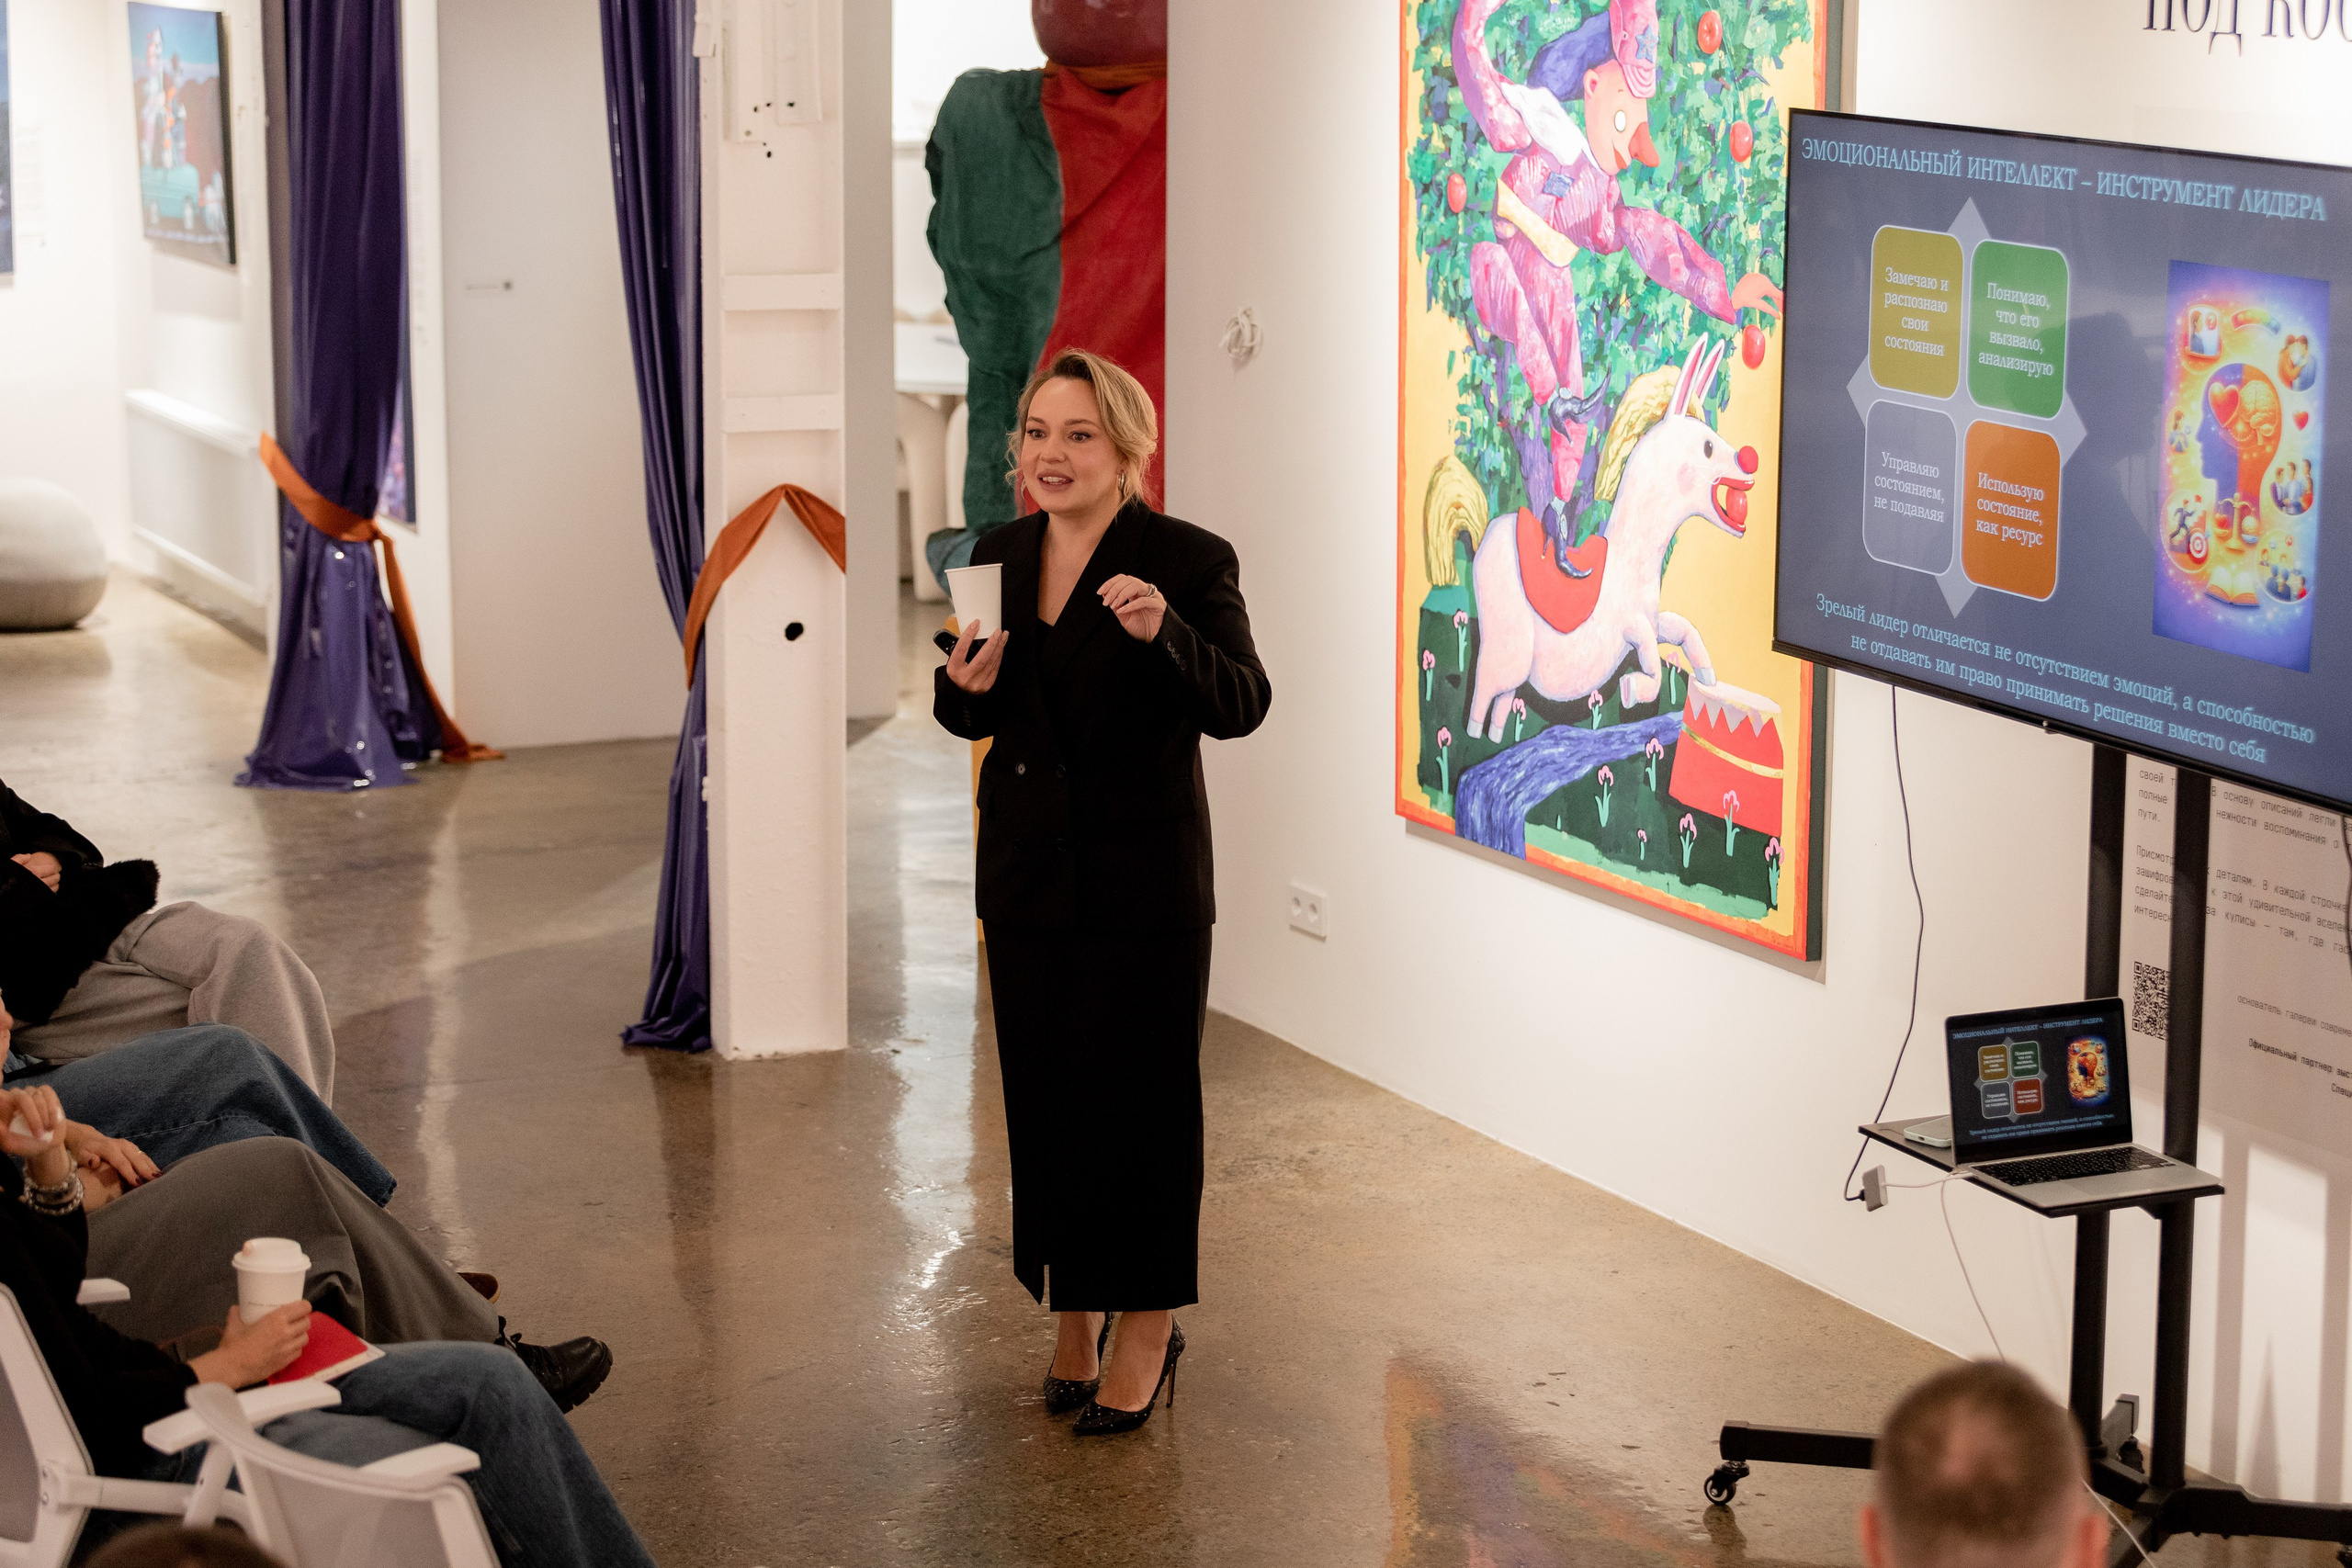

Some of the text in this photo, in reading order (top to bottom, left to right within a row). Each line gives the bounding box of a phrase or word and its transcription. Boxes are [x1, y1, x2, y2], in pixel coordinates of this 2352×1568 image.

[1802, 138, 1962, 177] ЭМОЦИОНАЛЬНЫЙ
[1966, 157, 2077, 191] ИНТЕЛЛЕКТ
[2096, 171, 2235, 209] ИНСТРУМЕНТ
[2238, 188, 2326, 221] ЛИДЕРА
[1884, 266, 1949, 291] Замечаю и
[1883, 292, 1948, 313] распознаю
[1986, 282, 2050, 310] Понимаю,
[1901, 317, 1928, 332] свои
[1996, 310, 2039, 328] что его
[1884, 335, 1944, 356] состояния
[1989, 332, 2043, 355] вызвало,
[1978, 352, 2053, 378] анализирую
[1882, 451, 1939, 479] Управляю
[1874, 475, 1944, 503] состоянием,
[1977, 471, 2044, 502] Использую
[1873, 496, 1944, 523] не подавляя
[1976, 498, 2042, 526] состояние,
[1975, 519, 2043, 547] как ресурс
[1816, 592, 2315, 744] Зрелый лидер отличается не отсутствием эмоций, а способностью
[1850, 635, 2267, 763] не отдавать им право принимать решения вместо себя
[2139, 769, 2164, 784] своей
[2222, 791, 2254, 808] основу
[2261, 799, 2302, 818] описаний
[2309, 811, 2336, 828] легли
[2137, 808, 2161, 823] пути.
[2138, 789, 2167, 804] полные
[2216, 808, 2256, 828] нежности
[2263, 821, 2326, 844] воспоминания
[2136, 845, 2175, 865] Присмотр
[2216, 868, 2256, 888] деталям.
[2273, 885, 2305, 901] каждой
[2135, 865, 2174, 885] зашифров
[2222, 889, 2243, 904] этой
[2248, 897, 2311, 922] удивительной
[2224, 911, 2256, 927] кулисы
[2308, 934, 2324, 947] где
[2236, 995, 2352, 1037] основатель галереи совреме
[2248, 1037, 2297, 1061] Официальный
[2301, 1055, 2333, 1075] партнер
